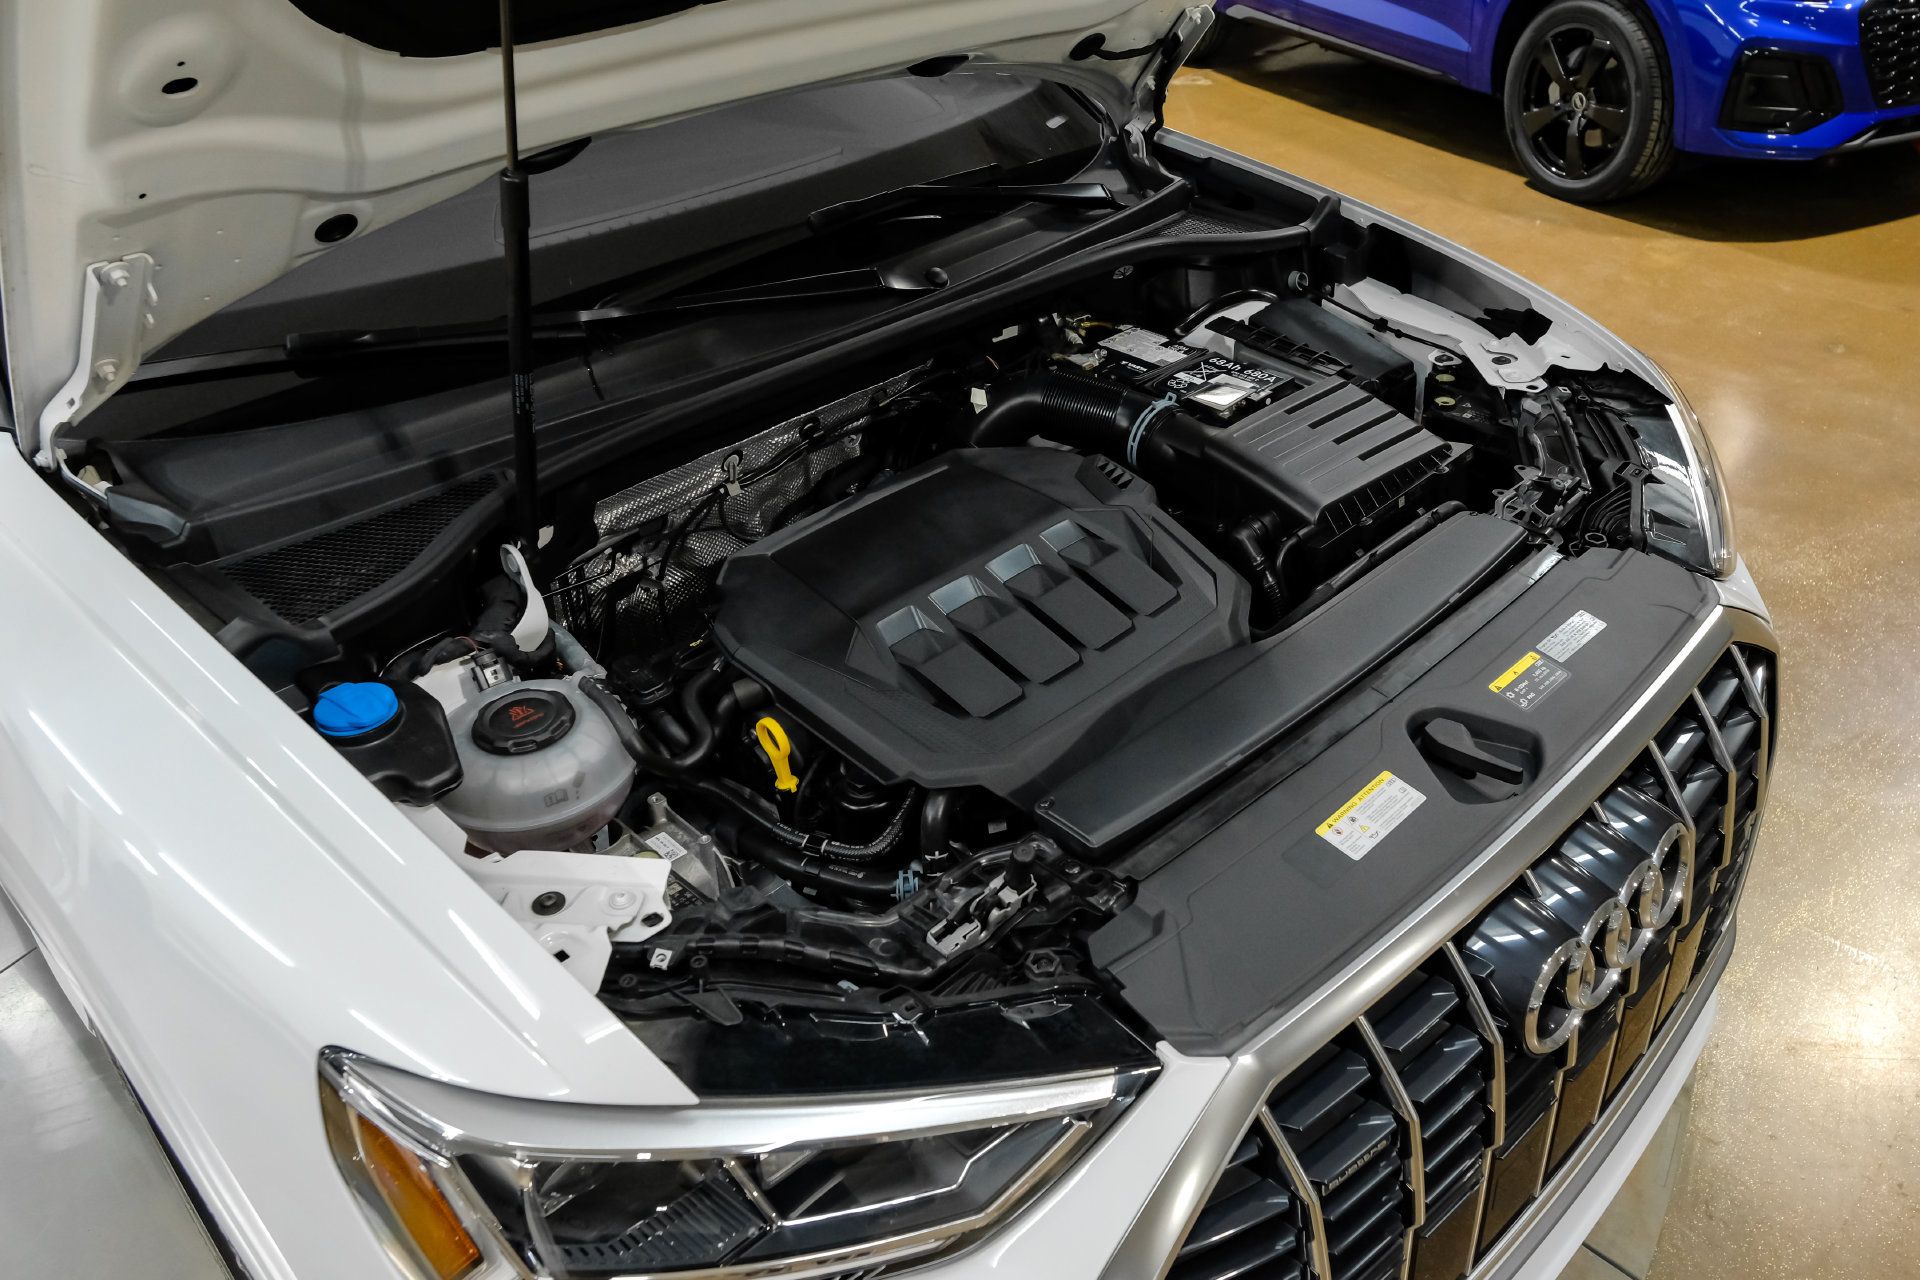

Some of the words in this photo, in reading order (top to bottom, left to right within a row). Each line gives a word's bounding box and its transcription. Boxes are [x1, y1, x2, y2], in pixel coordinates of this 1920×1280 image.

[1209, 358, 1241, 371] 68Ah
[1244, 369, 1276, 382] 680A
[1331, 801, 1358, 823] WARNING
[1357, 778, 1384, 802] ATTENTION
